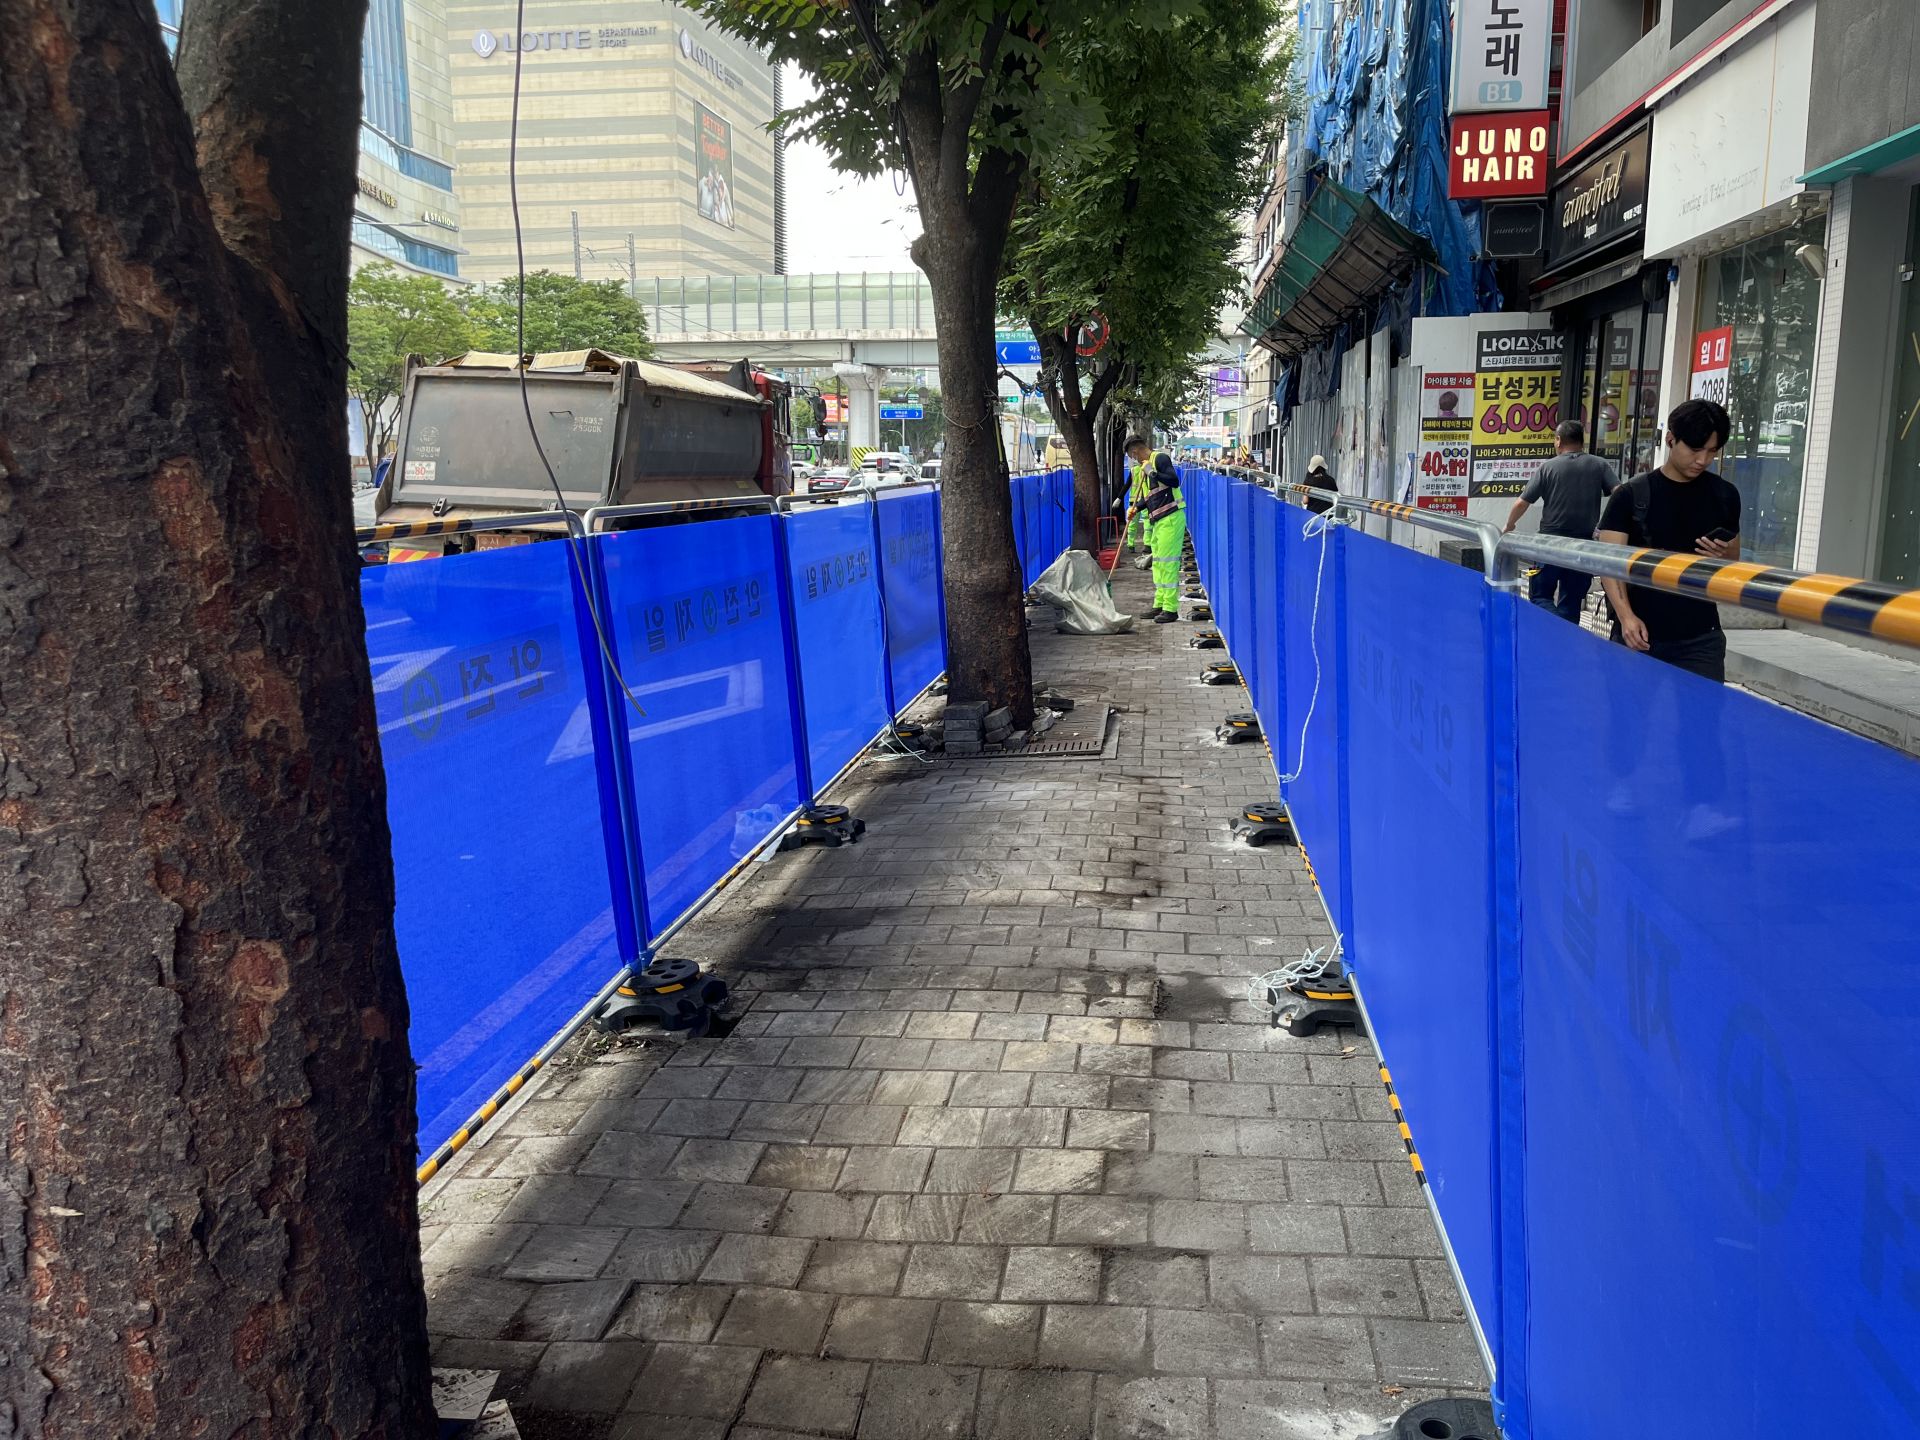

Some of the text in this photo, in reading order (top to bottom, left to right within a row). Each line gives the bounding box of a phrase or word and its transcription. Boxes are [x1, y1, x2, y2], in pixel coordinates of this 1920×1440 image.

[503, 29, 591, 53] LOTTE
[598, 26, 657, 37] DEPARTMENT
[599, 38, 627, 48] STORE
[690, 42, 724, 81] LOTTE
[1486, 83, 1512, 102] B1
[702, 113, 725, 138] BETTER
[1455, 126, 1547, 156] JUNO
[1462, 155, 1534, 183] HAIR
[430, 213, 455, 227] STATION
[1482, 336, 1530, 352] 나이스
[1700, 337, 1726, 366] 임대
[1458, 376, 1473, 386] 시술
[1475, 448, 1512, 457] 나이스가이
